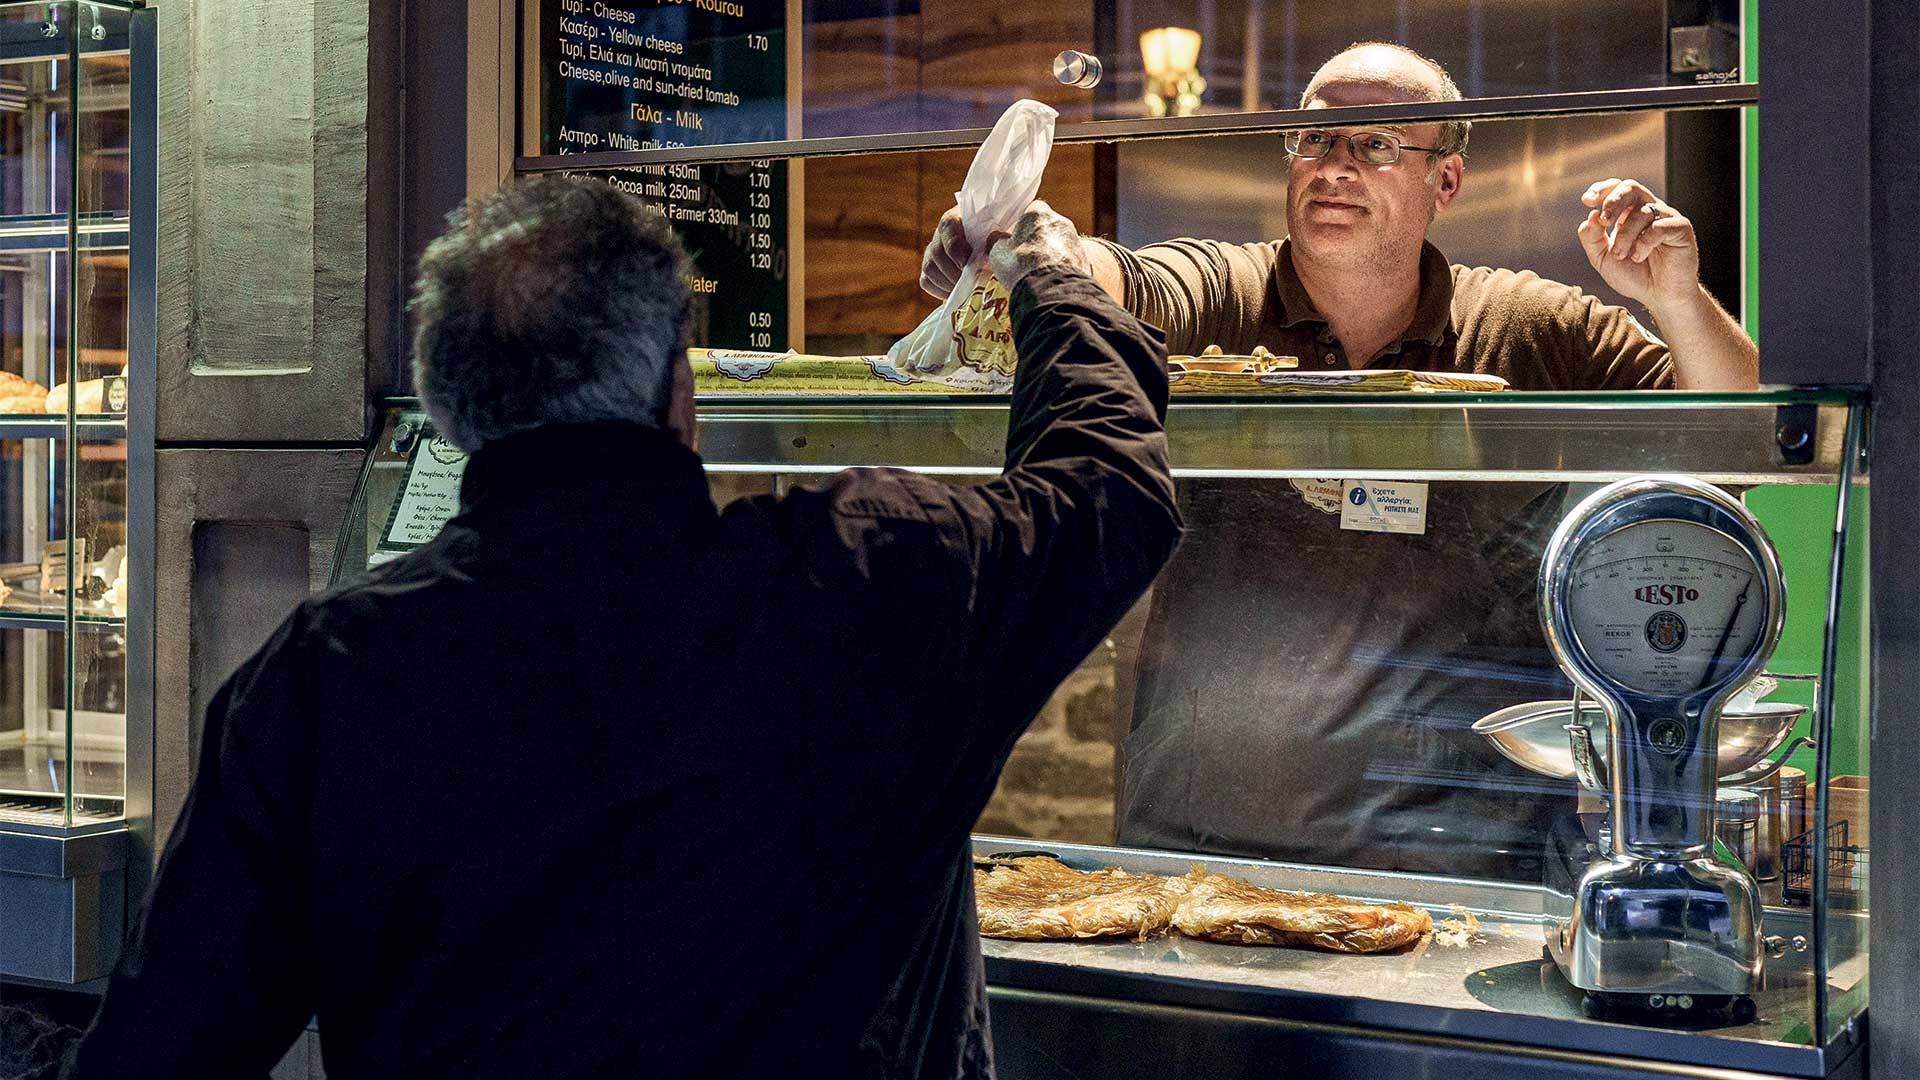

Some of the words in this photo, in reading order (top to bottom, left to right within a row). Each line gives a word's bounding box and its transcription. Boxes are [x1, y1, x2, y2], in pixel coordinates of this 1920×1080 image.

[593, 2, 636, 24] Cheese
[559, 16, 598, 41] Κασέρι
[608, 26, 643, 46] Yellow
[645, 34, 683, 55] cheese
[747, 33, 768, 51] 1.70
[559, 38, 586, 60] Τυρί,
[589, 44, 614, 63] Ελιά
[616, 52, 632, 66] και
[635, 52, 668, 77] λιαστή
[672, 62, 712, 81] ντομάτα
[632, 76, 653, 91] and
[655, 80, 703, 100] sun-dried
[705, 89, 740, 107] tomato
[630, 102, 663, 125] Γάλα
[676, 109, 703, 129] Milk
[559, 125, 599, 148] Ασπρο
[608, 132, 640, 151] White
[668, 163, 700, 181] 450ml
[749, 172, 770, 189] 1.70
[608, 175, 643, 195] Cocoa
[645, 181, 667, 198] milk
[669, 183, 701, 201] 250ml
[749, 192, 770, 208] 1.20
[646, 203, 667, 218] milk
[669, 204, 706, 223] Farmer
[708, 209, 738, 225] 330ml
[749, 212, 771, 229] 1.00
[749, 233, 771, 249] 1.50
[750, 253, 771, 269] 1.20
[749, 311, 772, 328] 0.50
[749, 332, 772, 348] 1.00
